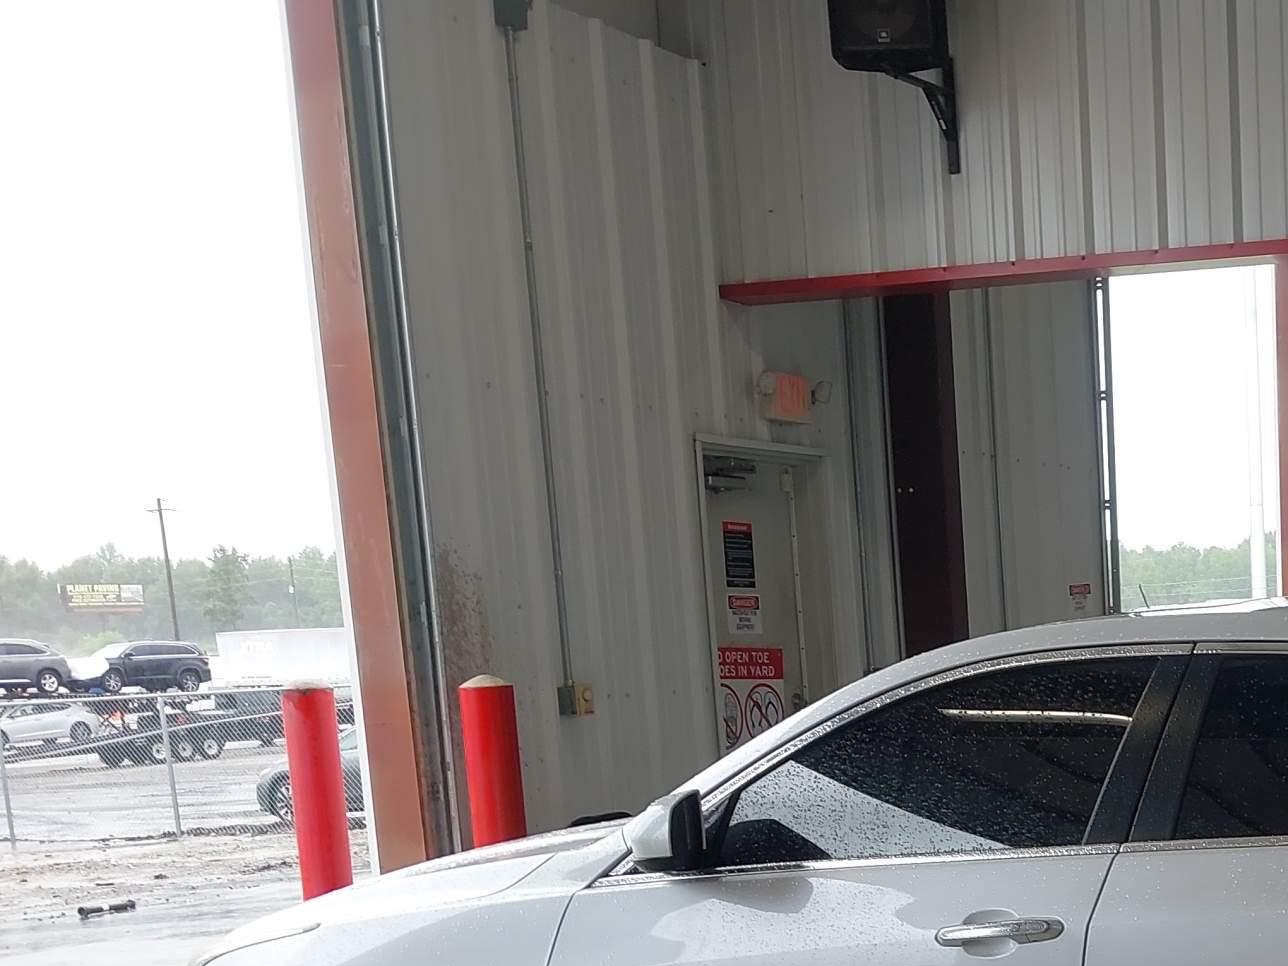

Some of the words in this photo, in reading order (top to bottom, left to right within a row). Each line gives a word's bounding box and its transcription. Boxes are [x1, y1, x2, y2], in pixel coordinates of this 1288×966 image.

[724, 651, 749, 663] OPEN
[752, 652, 769, 663] TOE
[720, 664, 736, 676] OES
[738, 665, 747, 676] IN
[750, 665, 775, 677] YARD
